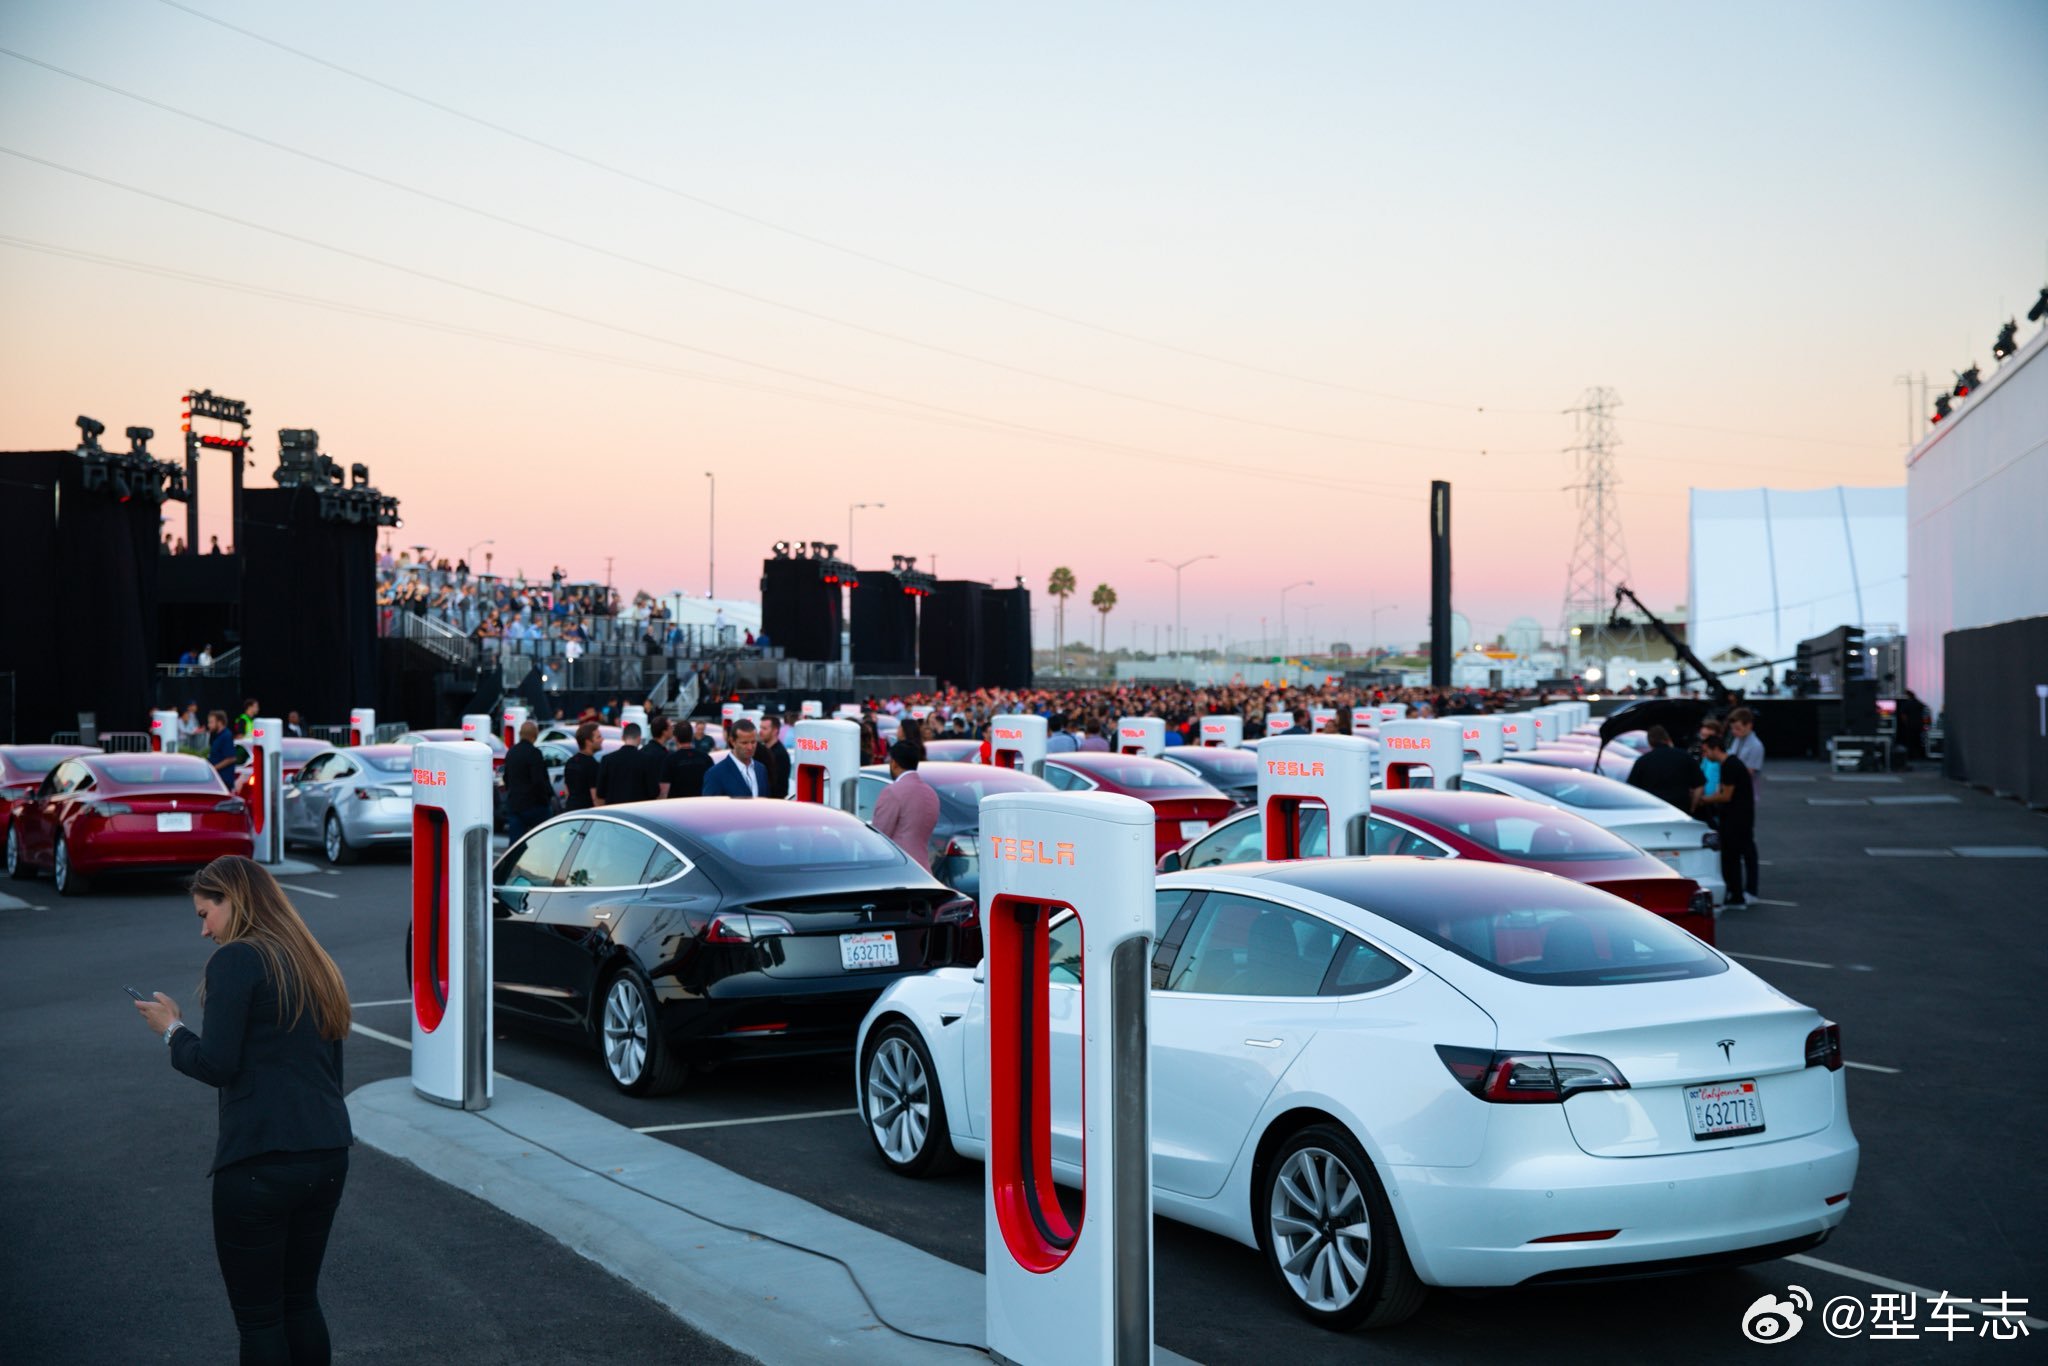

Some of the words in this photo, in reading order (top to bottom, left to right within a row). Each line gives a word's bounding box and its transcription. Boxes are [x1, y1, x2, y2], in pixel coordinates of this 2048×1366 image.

[797, 738, 828, 751] TESLA
[1387, 737, 1430, 750] TESLA
[413, 768, 446, 786] TESLA
[1267, 761, 1324, 776] TESLA
[991, 836, 1075, 865] TESLA
[853, 944, 886, 961] 63277
[1705, 1099, 1748, 1127] 63277
